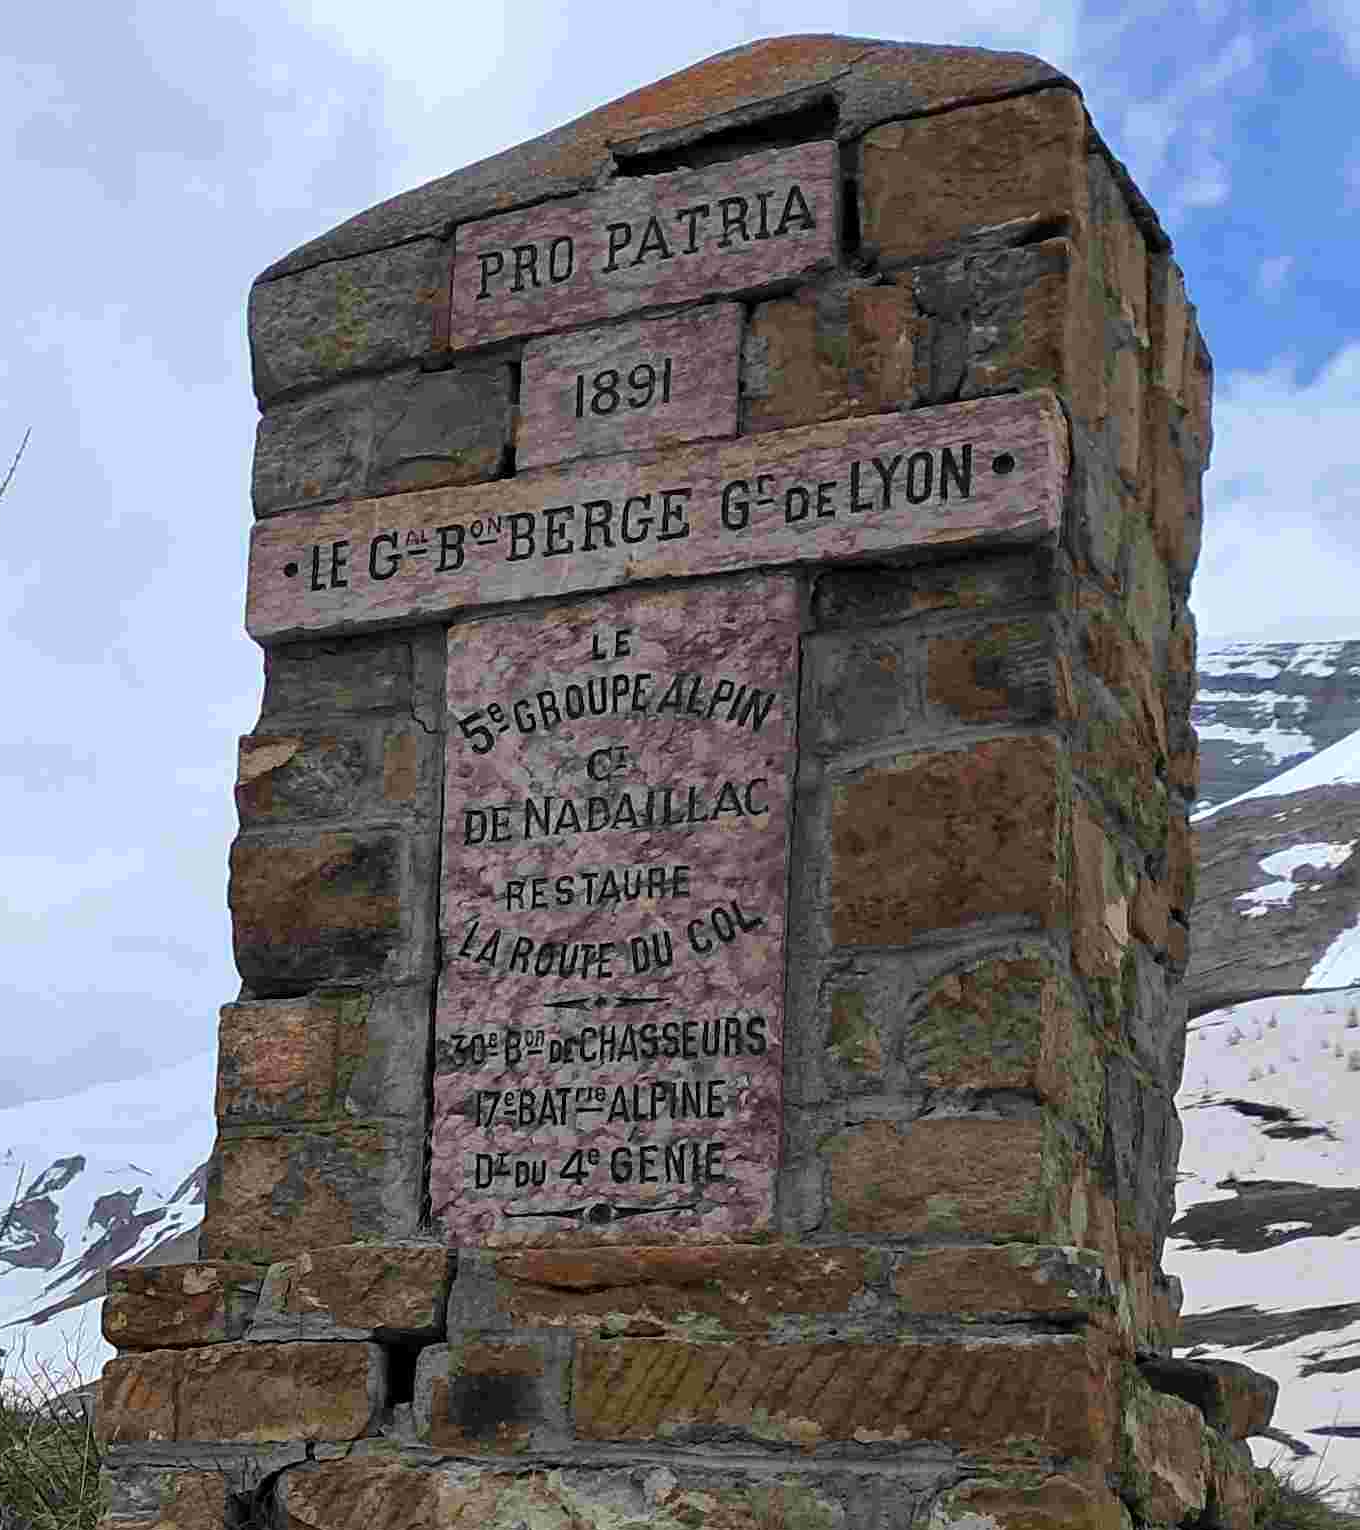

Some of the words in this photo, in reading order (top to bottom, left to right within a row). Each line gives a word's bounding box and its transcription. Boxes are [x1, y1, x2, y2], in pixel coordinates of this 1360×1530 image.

[477, 235, 575, 299] PRO
[602, 185, 817, 273] PATRIA
[576, 358, 672, 418] 1891
[310, 541, 350, 592] LE
[504, 488, 693, 562] BERGE
[784, 481, 837, 523] DE
[850, 444, 973, 514] LYON
[591, 629, 632, 661] LE
[513, 673, 652, 734] GROUPE
[657, 672, 776, 731] ALPIN
[463, 806, 513, 846] DE
[524, 778, 769, 841] NADAILLAC
[506, 865, 691, 911] RESTAURE
[458, 921, 502, 968] LA
[509, 936, 616, 979] ROUTE
[630, 930, 673, 973] DU
[687, 900, 764, 954] COL
[549, 1038, 578, 1064] DE
[579, 1017, 768, 1063] CHASSEURS
[607, 1080, 727, 1122] ALPINE
[515, 1160, 547, 1188] DU
